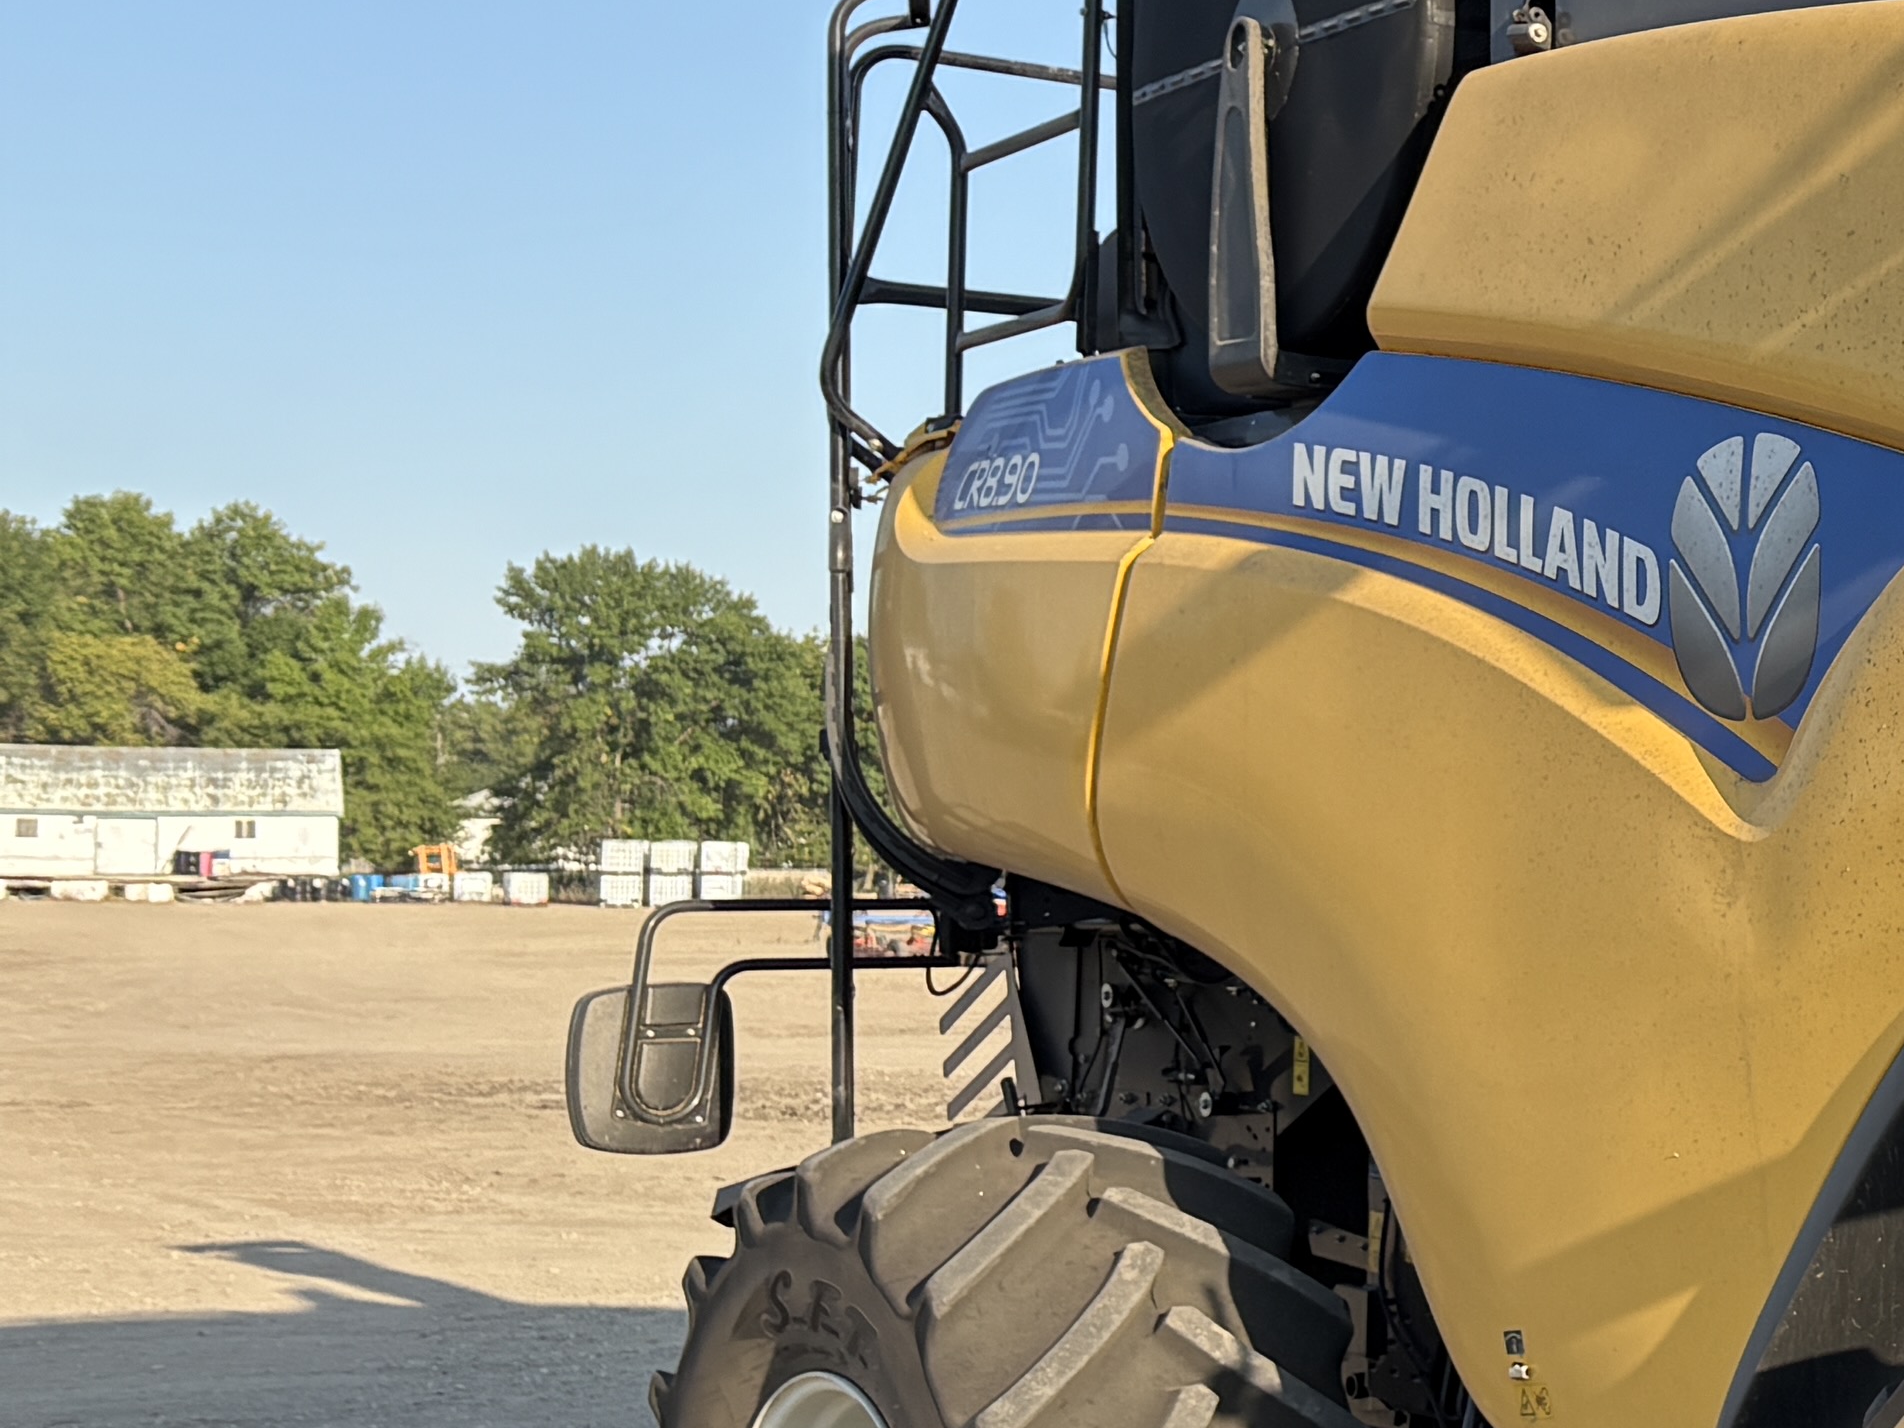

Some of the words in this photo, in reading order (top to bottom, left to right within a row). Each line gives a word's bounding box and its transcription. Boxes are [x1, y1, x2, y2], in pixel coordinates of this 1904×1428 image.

[953, 452, 1040, 510] CR8.90
[1292, 442, 1406, 526] NEW
[1418, 464, 1661, 626] HOLLAND
